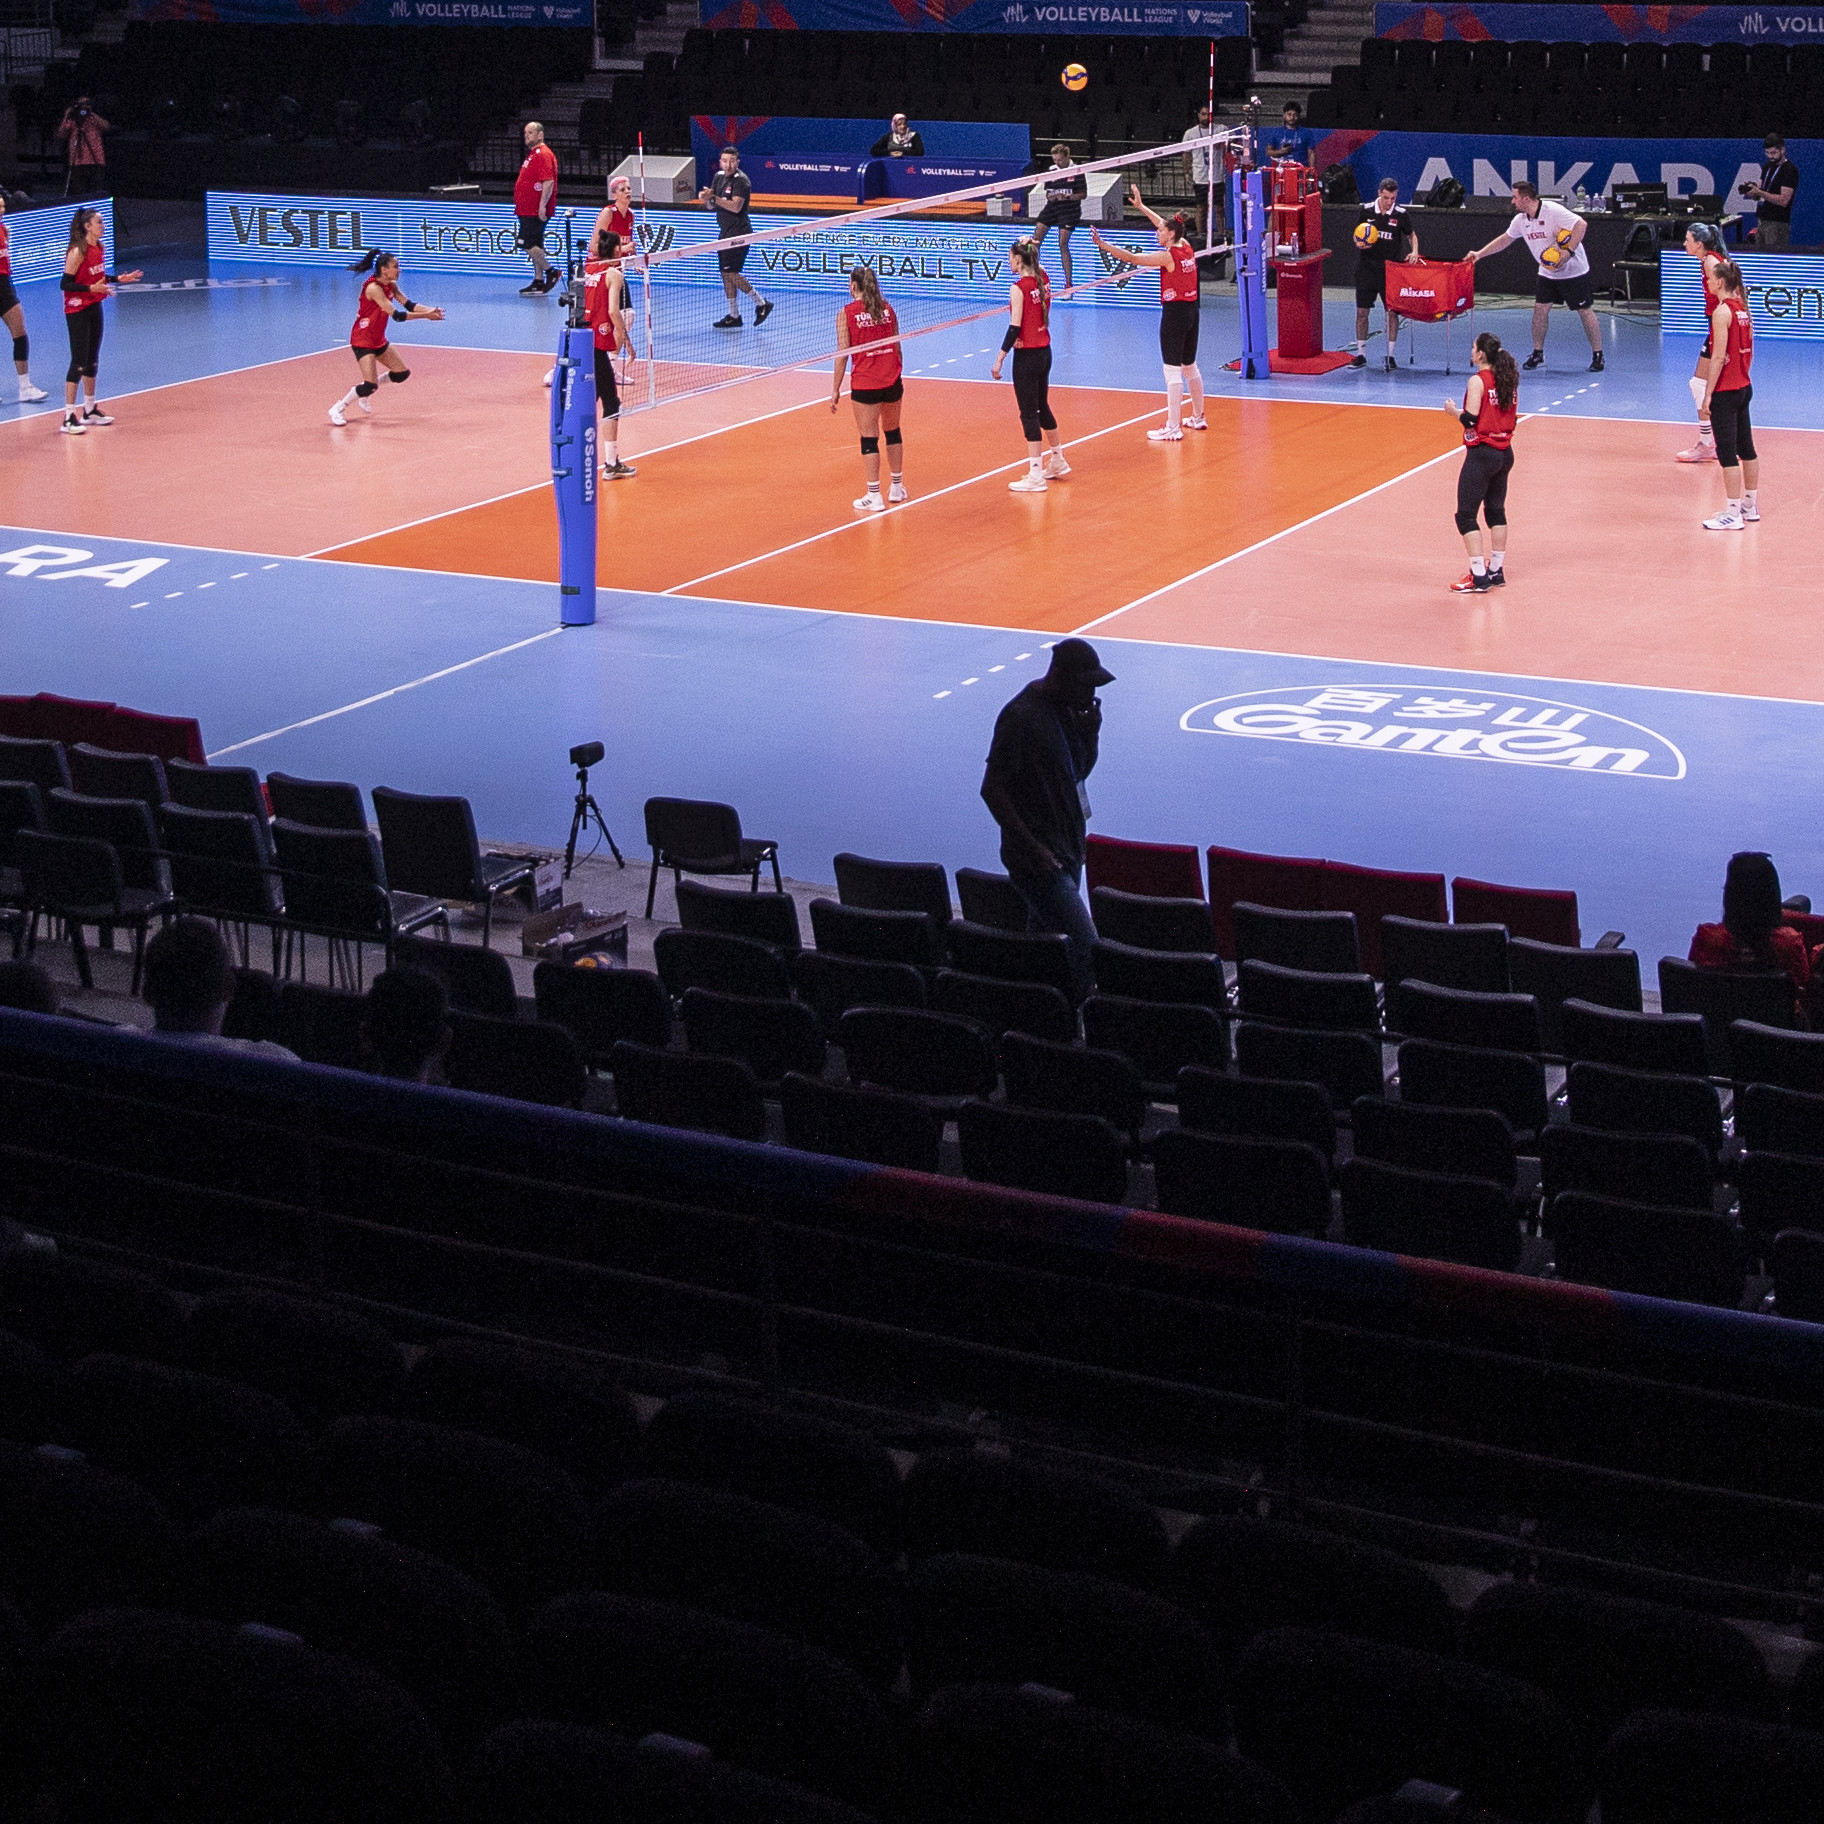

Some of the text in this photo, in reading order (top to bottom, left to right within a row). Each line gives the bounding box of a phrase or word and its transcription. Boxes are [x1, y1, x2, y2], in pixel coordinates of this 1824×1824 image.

[416, 3, 506, 18] VOLLEYBALL
[1034, 6, 1143, 23] VOLLEYBALL
[779, 163, 819, 172] VOLLEYBALL
[921, 167, 963, 177] VOLLEYBALL
[1415, 156, 1767, 215] ANKARA
[228, 206, 376, 251] VESTEL
[975, 239, 999, 252] ON
[760, 249, 1003, 282] VOLLEYBALL TV
[584, 445, 597, 503] Senoh
[1303, 687, 1591, 732] 百岁山
